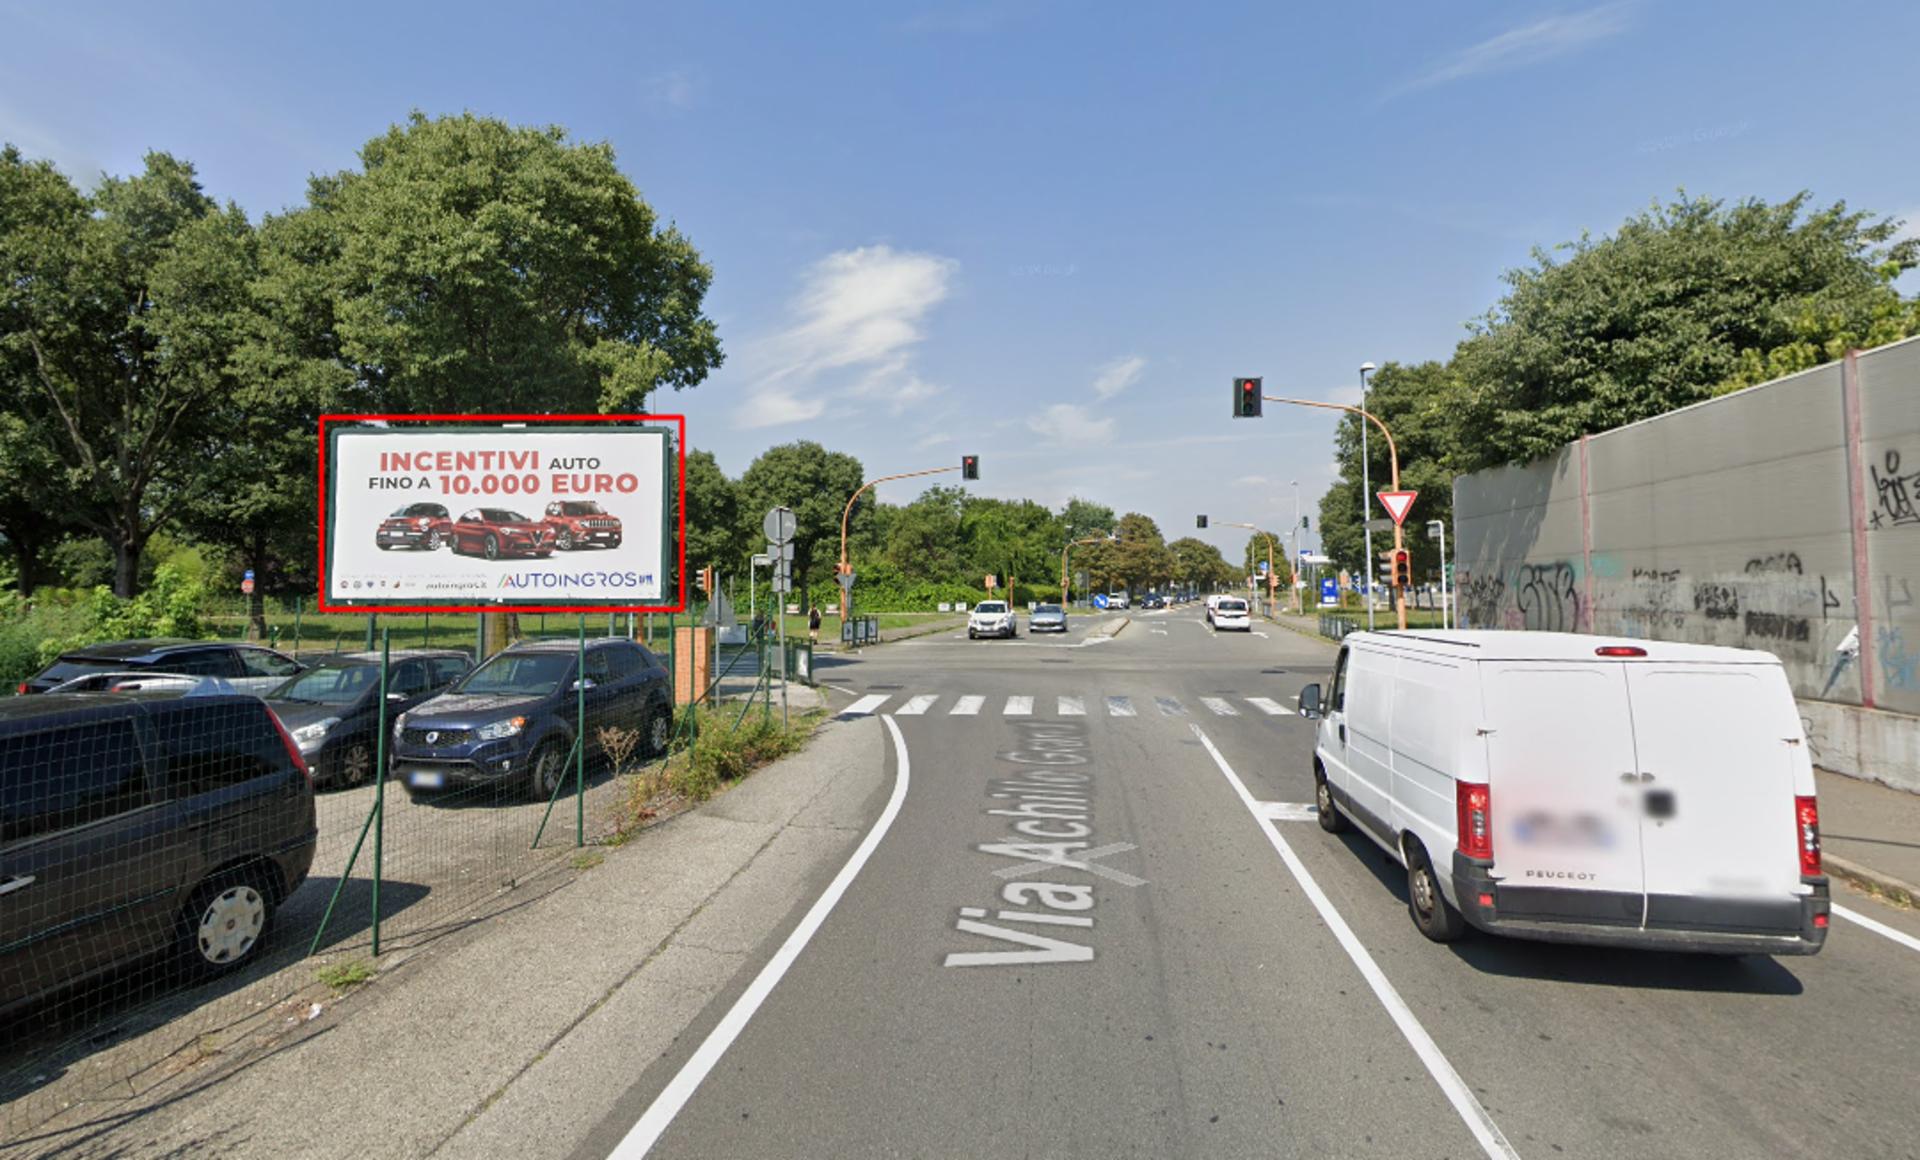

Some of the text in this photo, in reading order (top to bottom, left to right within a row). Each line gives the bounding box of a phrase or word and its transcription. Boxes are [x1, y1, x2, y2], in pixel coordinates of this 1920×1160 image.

[380, 451, 600, 472] INCENTIVI AUTO
[369, 473, 638, 495] FINO A 10.000 EURO
[1526, 870, 1597, 881] PEUGEOT
